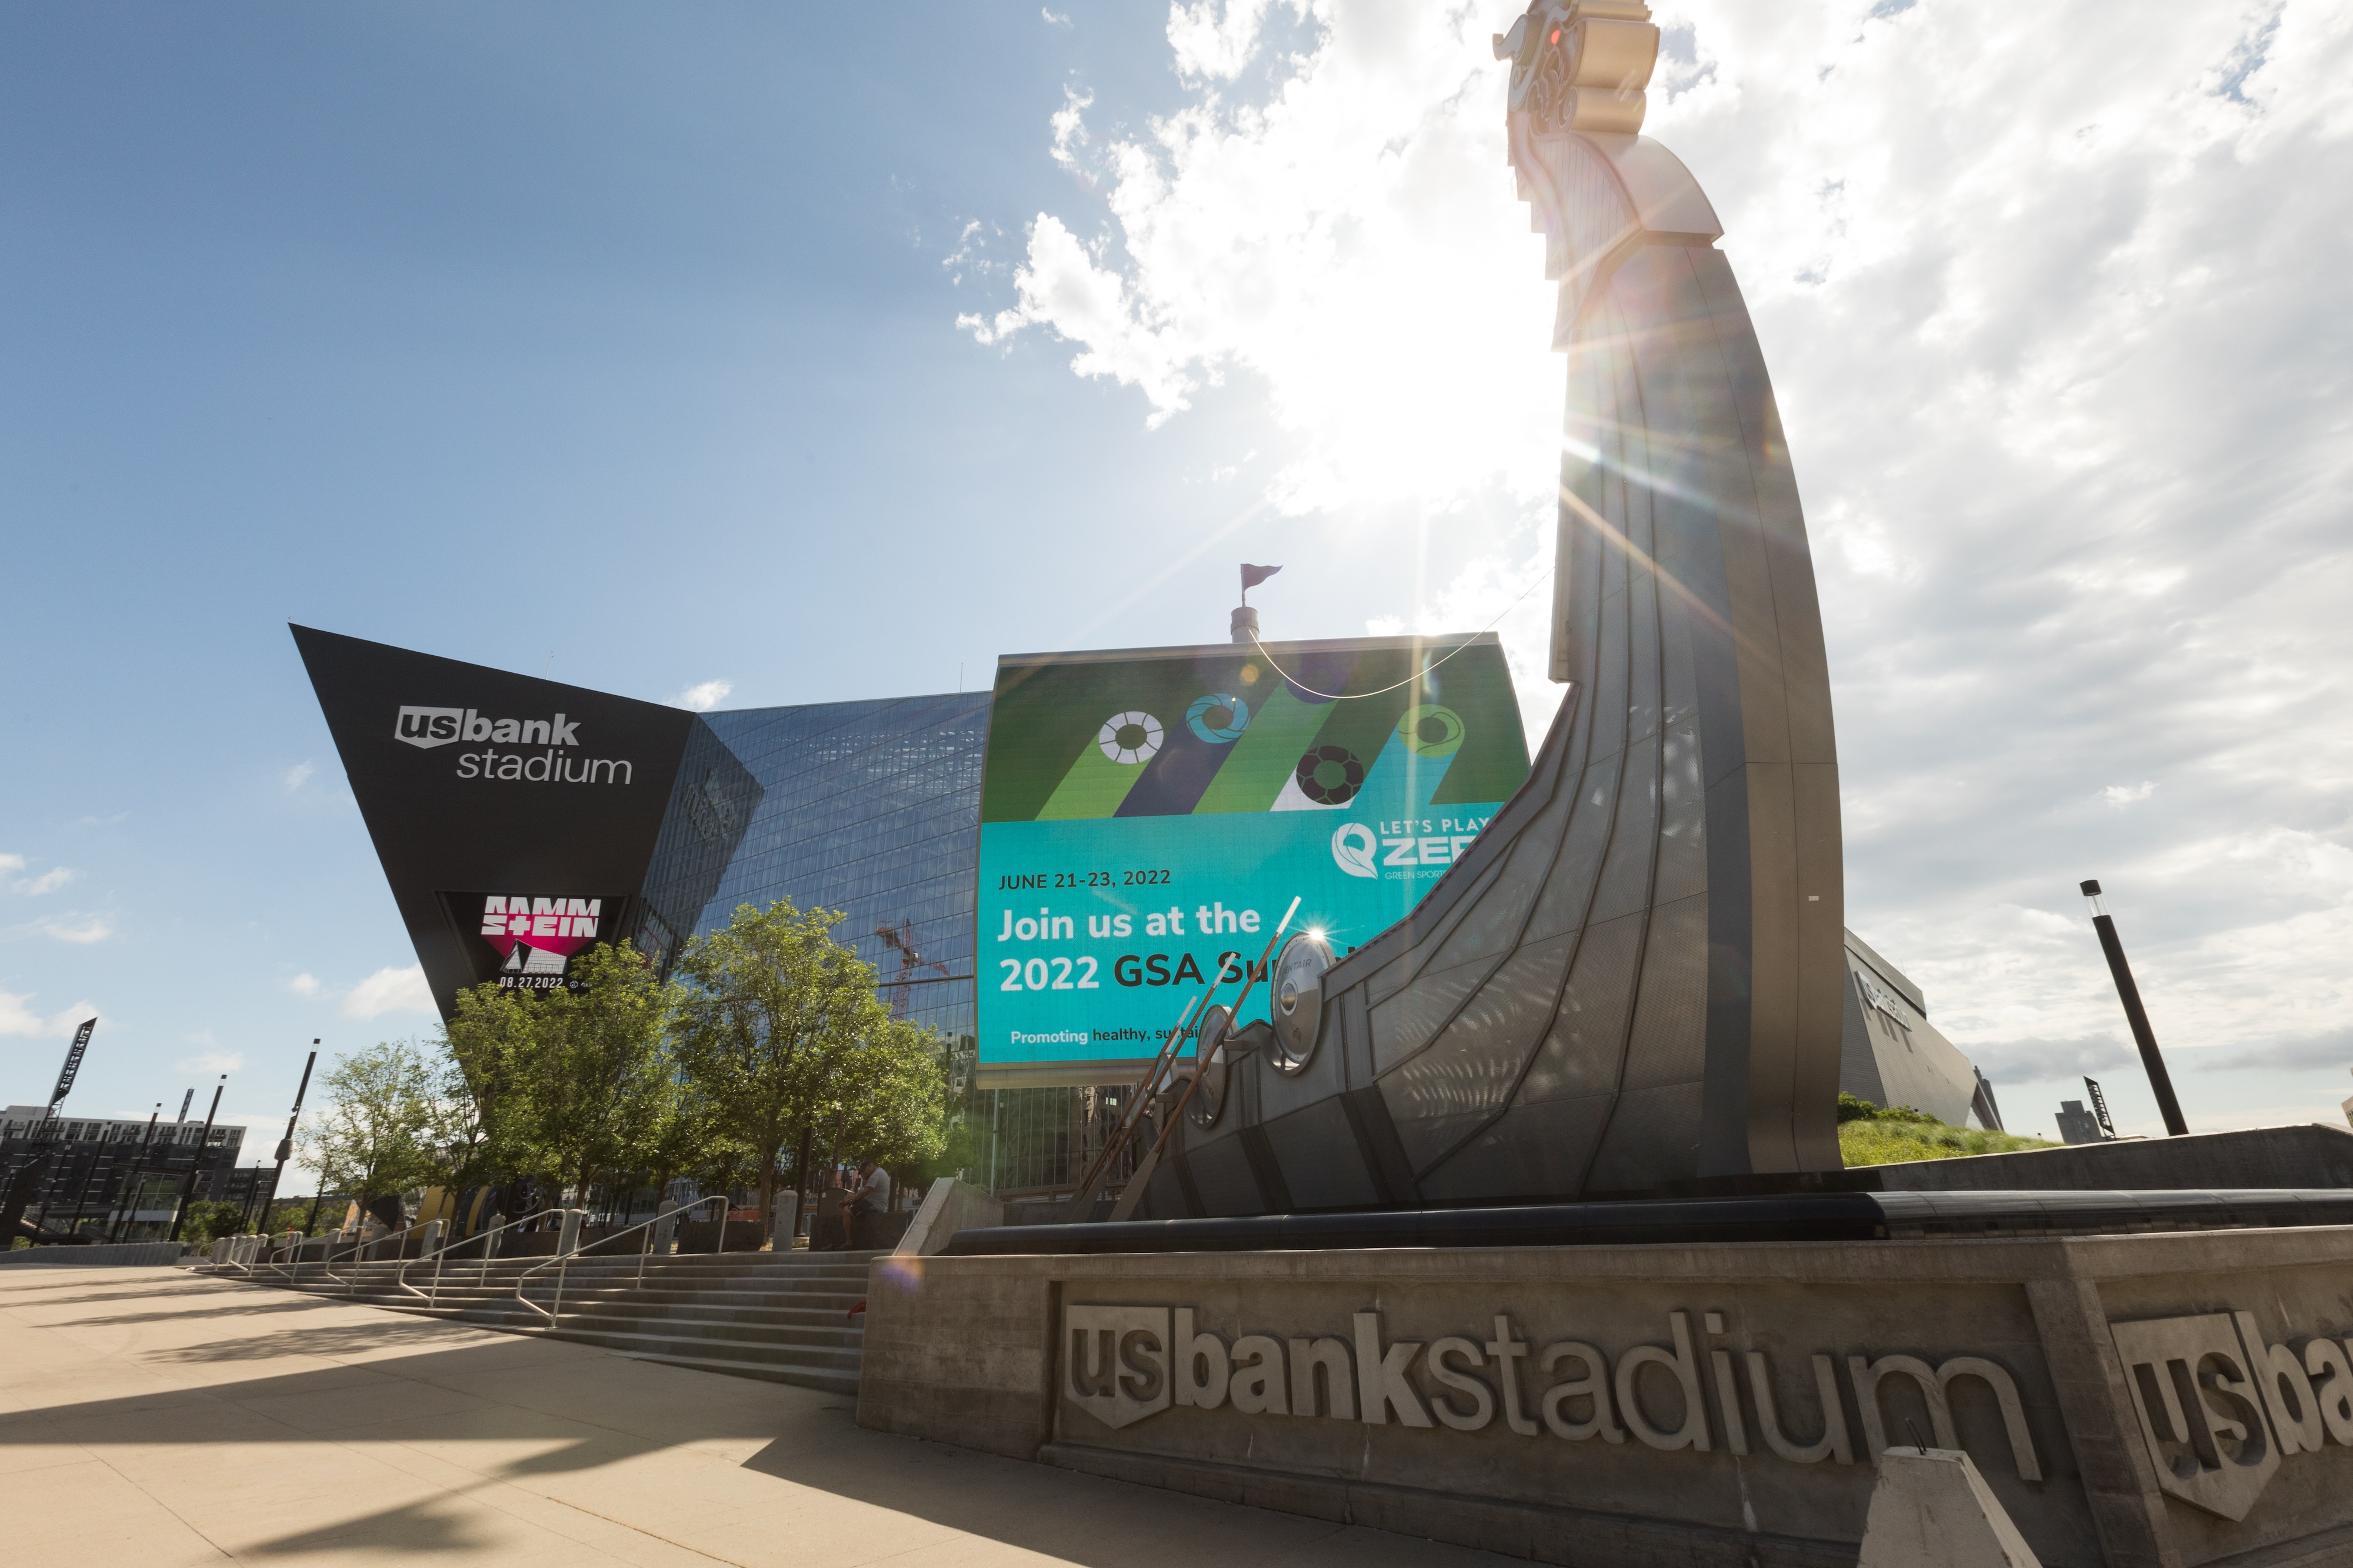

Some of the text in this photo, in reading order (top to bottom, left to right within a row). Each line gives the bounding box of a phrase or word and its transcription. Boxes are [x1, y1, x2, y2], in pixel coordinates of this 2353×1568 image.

[456, 748, 632, 785] stadium
[1380, 820, 1432, 834] LET'S
[998, 869, 1171, 890] JUNE 21-23, 2022
[1385, 871, 1415, 880] GREEN
[484, 896, 601, 916] RAMM
[481, 915, 598, 938] STEIN
[998, 902, 1261, 942] Join us at the
[499, 976, 564, 988] 08.27.2022
[1000, 956, 1099, 992] 2022
[1114, 952, 1205, 987] GSA
[1011, 1029, 1088, 1046] Promoting
[1092, 1027, 1151, 1043] healthy,
